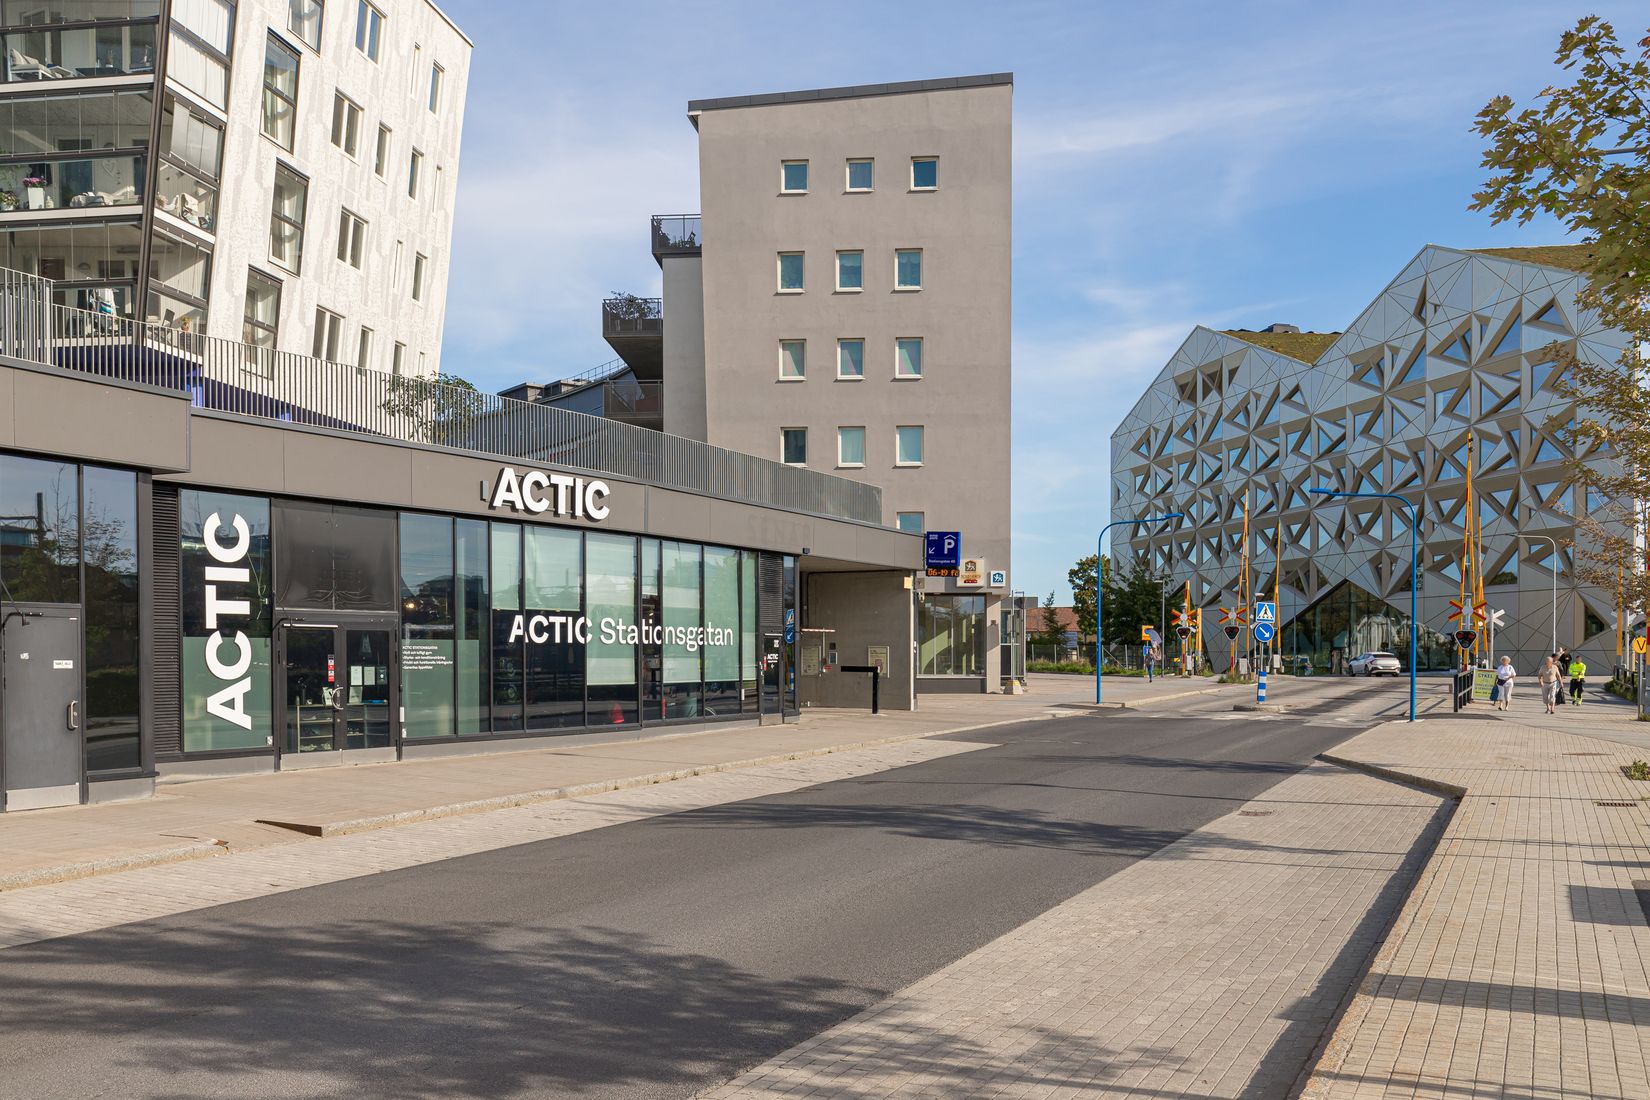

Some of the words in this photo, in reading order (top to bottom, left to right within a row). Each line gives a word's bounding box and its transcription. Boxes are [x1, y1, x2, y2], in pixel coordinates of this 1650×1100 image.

[491, 467, 611, 520] ACTIC
[203, 511, 252, 731] ACTIC
[508, 614, 593, 645] ACTIC
[600, 616, 734, 652] Stationsgatan
[1636, 639, 1646, 651] V
